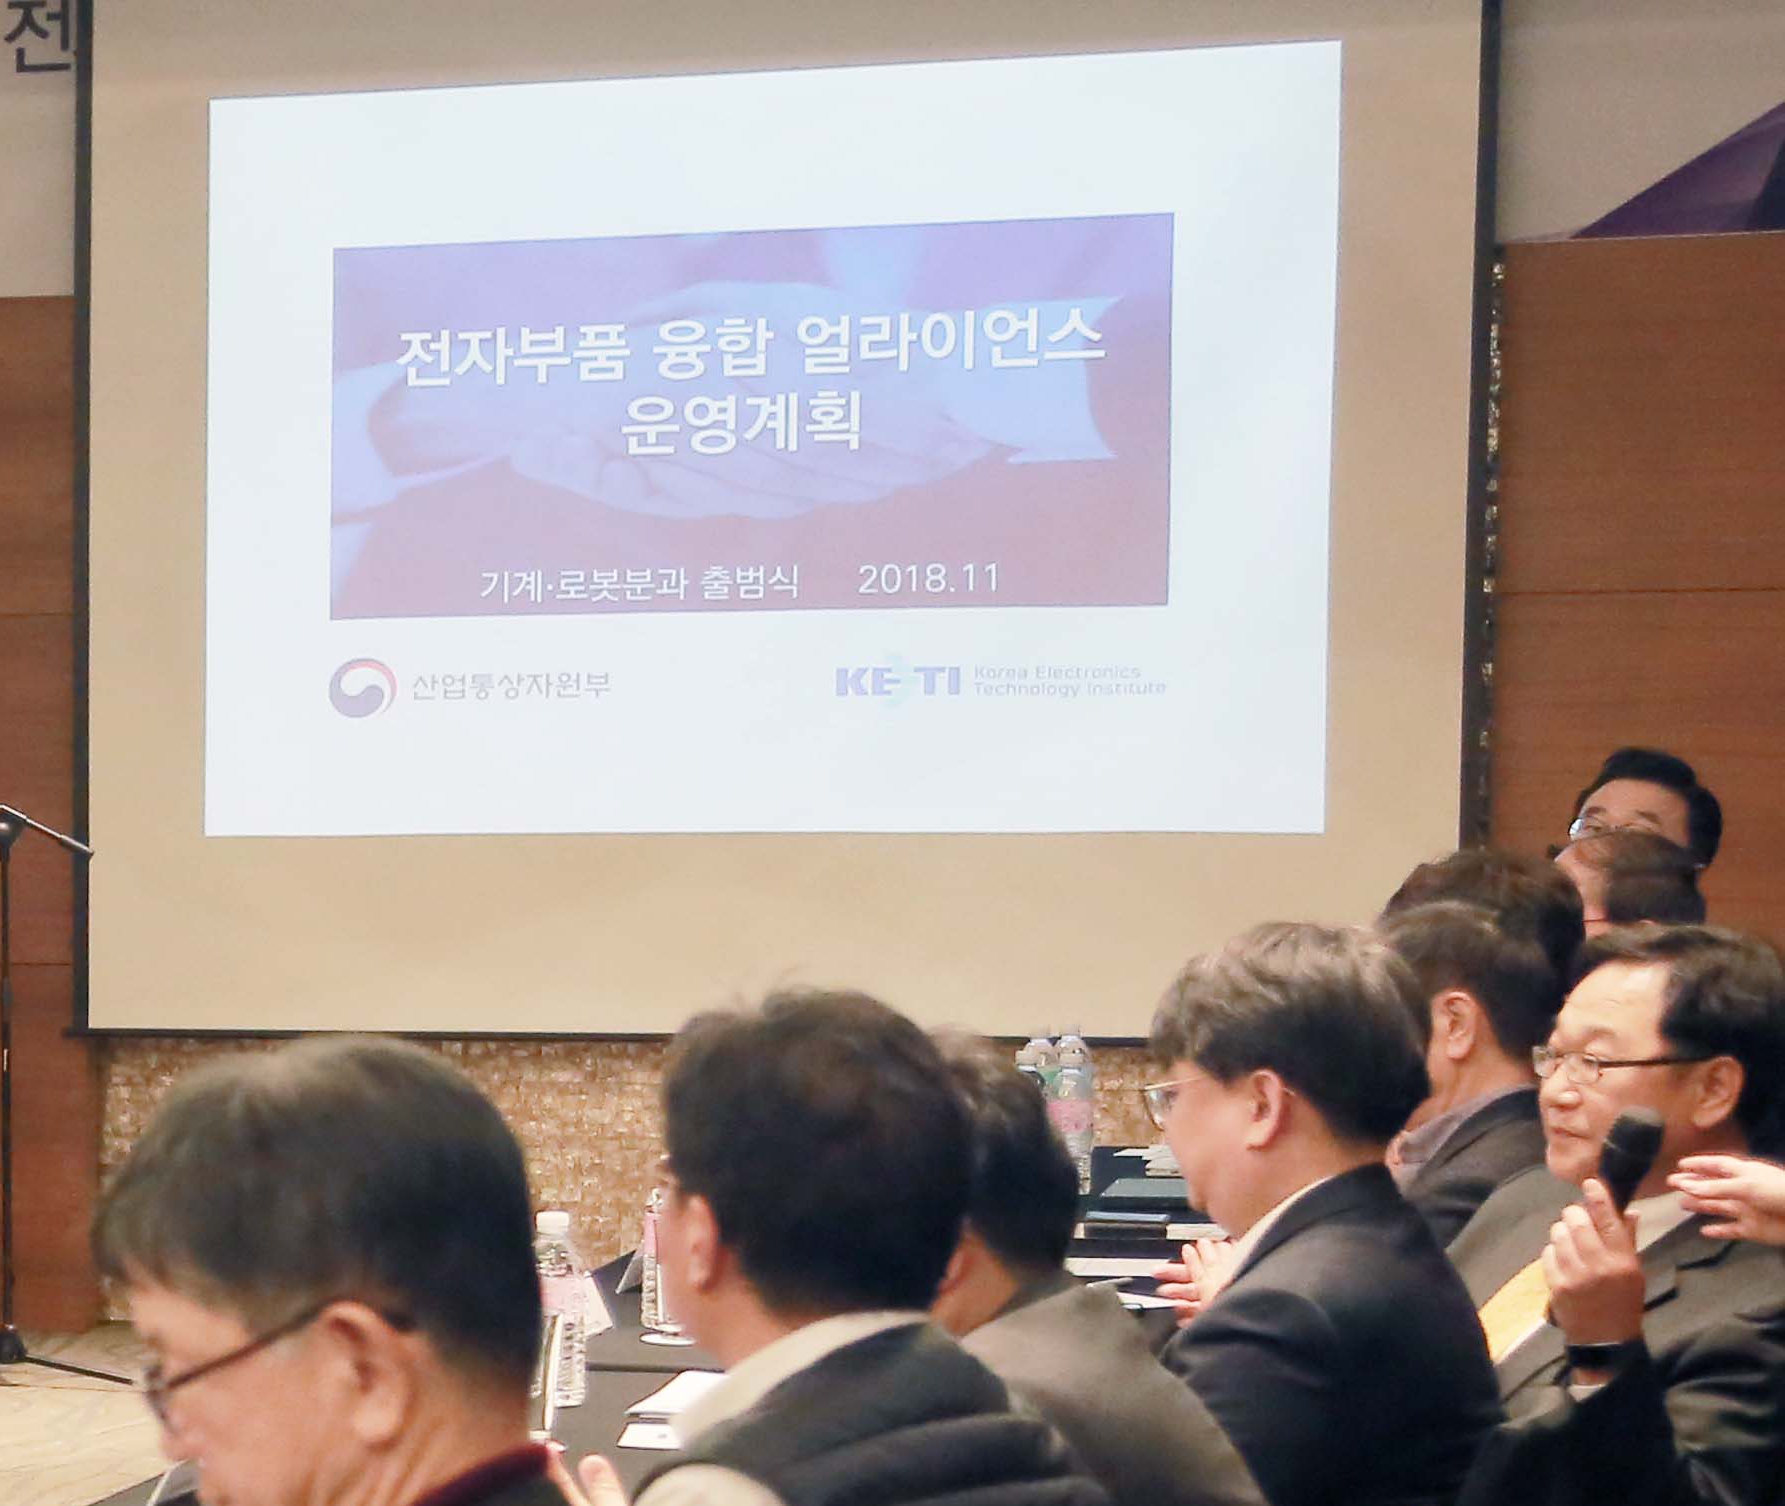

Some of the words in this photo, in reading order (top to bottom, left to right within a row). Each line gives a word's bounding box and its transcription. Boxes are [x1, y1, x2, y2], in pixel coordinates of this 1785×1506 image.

[3, 0, 71, 73] 전
[396, 322, 631, 388] 전자부품
[652, 317, 775, 379] 융합
[796, 306, 1107, 374] 얼라이언스
[621, 390, 862, 456] 운영계획
[700, 564, 800, 600] 출범식
[857, 562, 1000, 595] 2018.11
[413, 672, 612, 700] 산업통상자원부
[835, 665, 961, 697] KETI
[973, 664, 1028, 681] Korea
[1034, 663, 1142, 680] Electronics
[973, 681, 1080, 699] Technology
[1087, 681, 1167, 696] Institute
